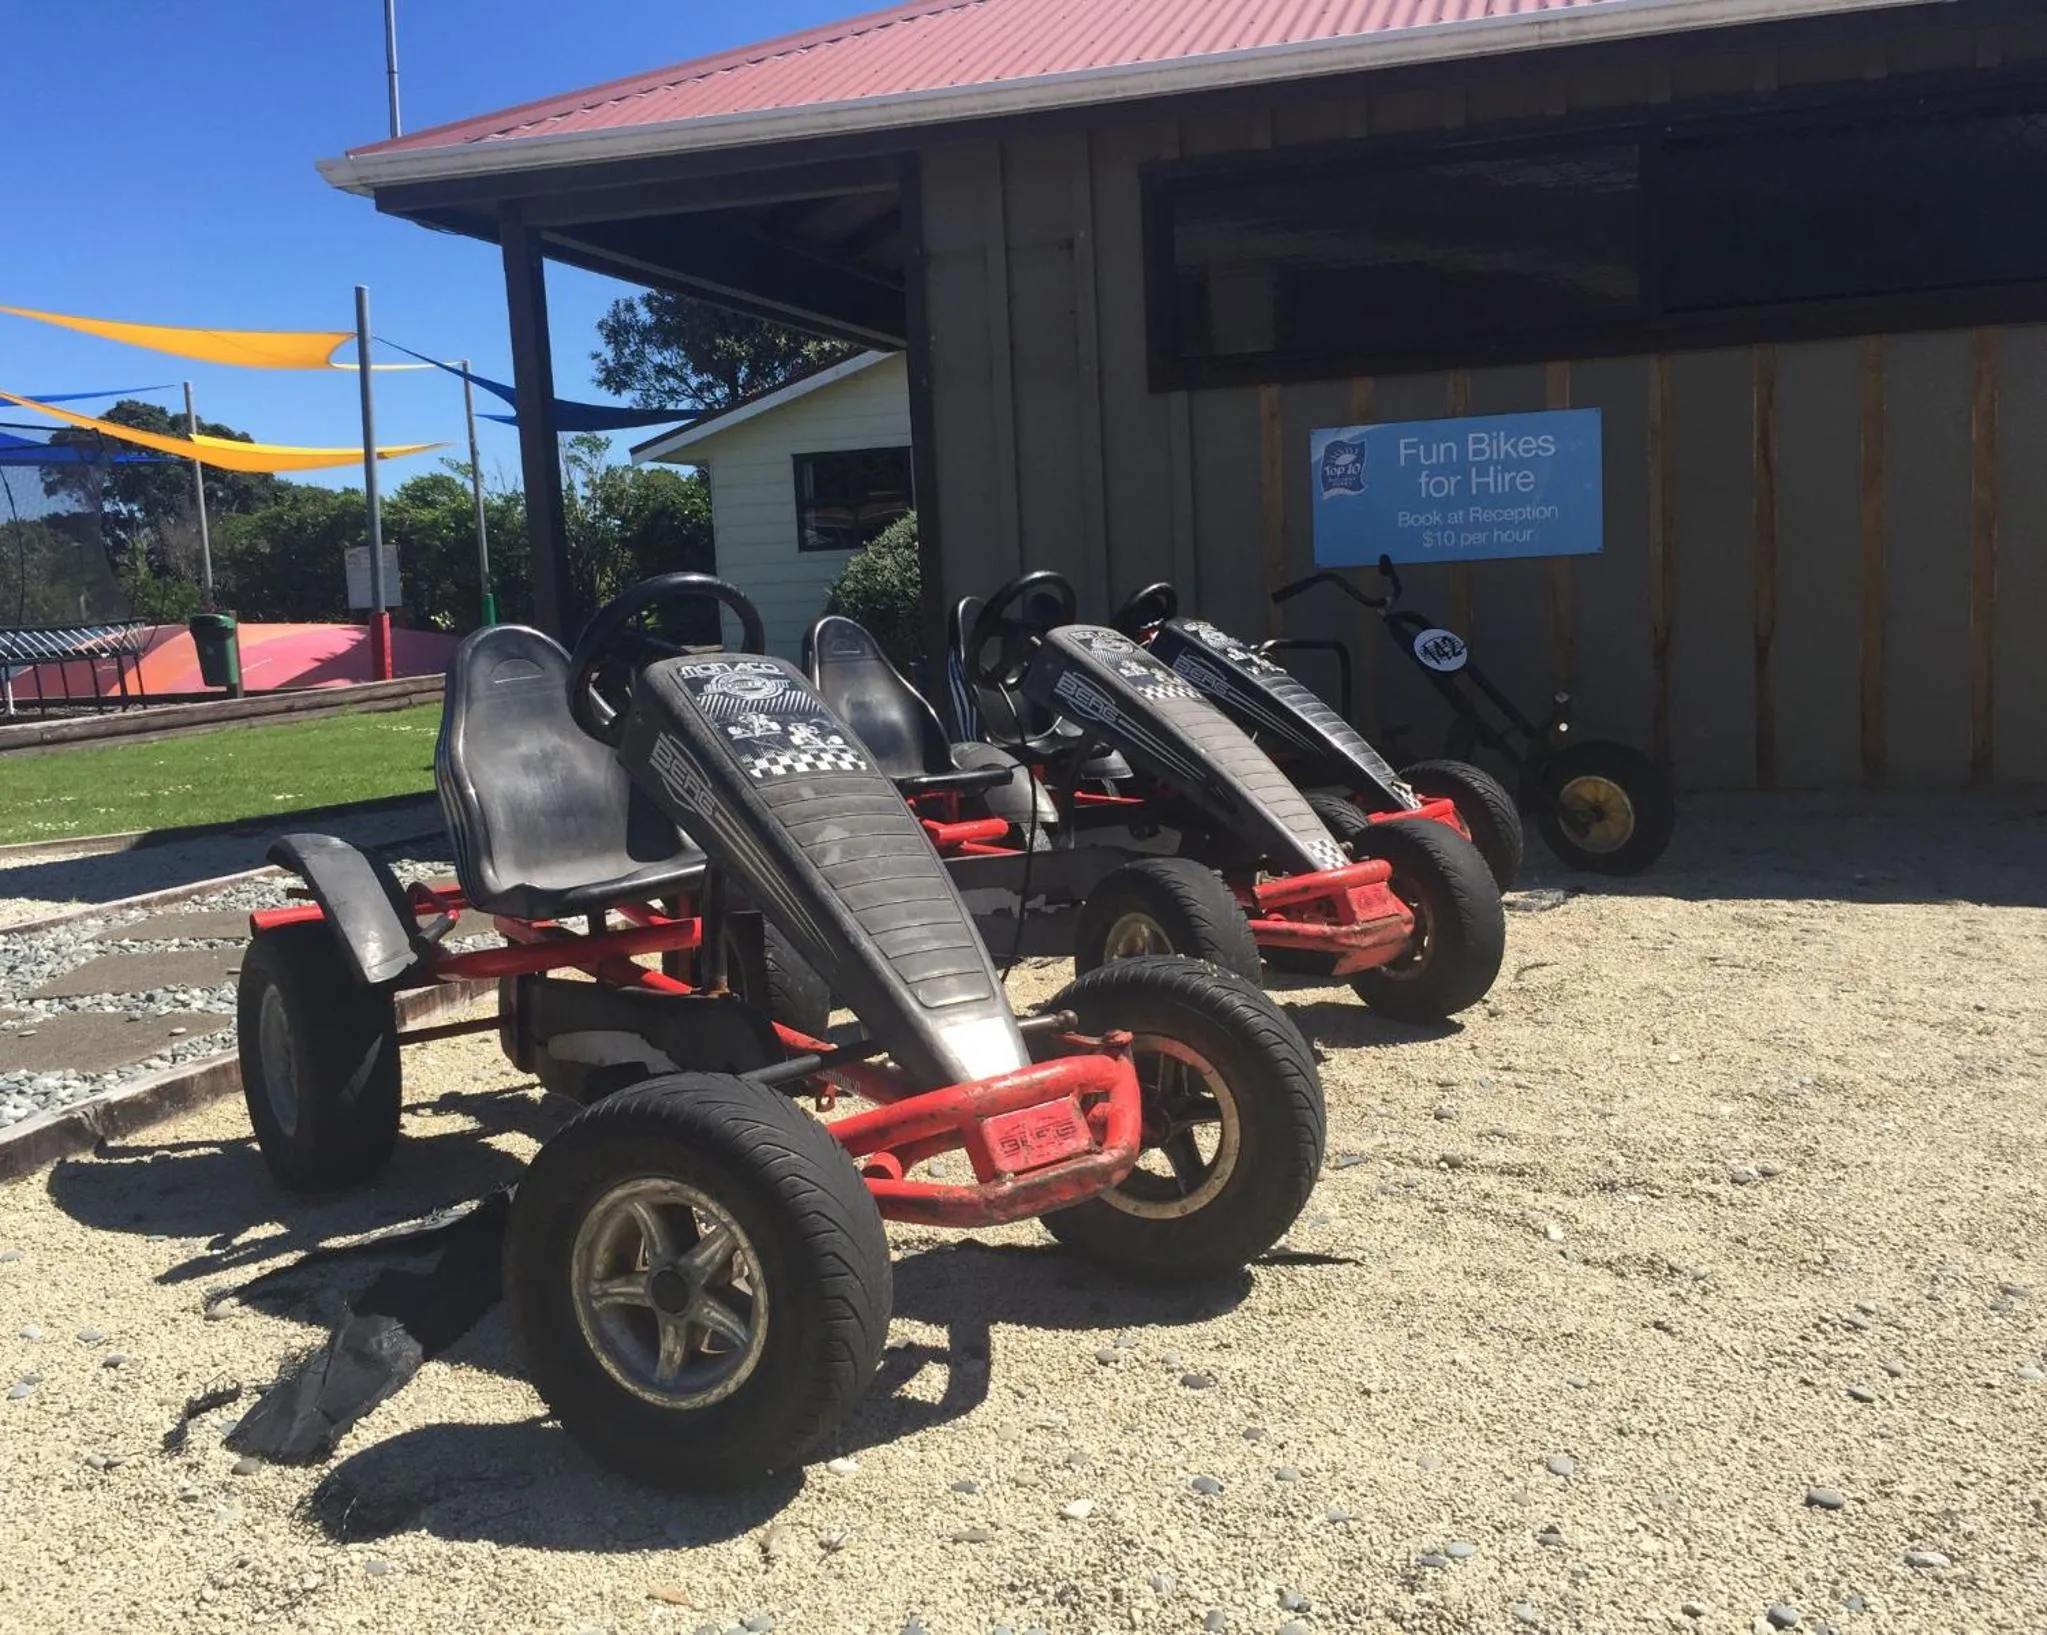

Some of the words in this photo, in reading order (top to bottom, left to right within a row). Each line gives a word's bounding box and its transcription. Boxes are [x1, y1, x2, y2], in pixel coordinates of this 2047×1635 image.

[1399, 438, 1457, 466] Fun
[1467, 431, 1556, 461] Bikes
[1419, 470, 1461, 498] for
[1471, 465, 1535, 495] Hire
[1398, 511, 1442, 527] Book
[1448, 510, 1464, 524] at
[1469, 504, 1559, 524] Reception
[1422, 530, 1455, 548] $10
[1460, 531, 1488, 548] per
[1493, 529, 1534, 543] hour
[681, 662, 780, 678] MONACO
[1172, 655, 1229, 696] BERG
[1056, 674, 1119, 722] BERG
[651, 738, 715, 815] BERG
